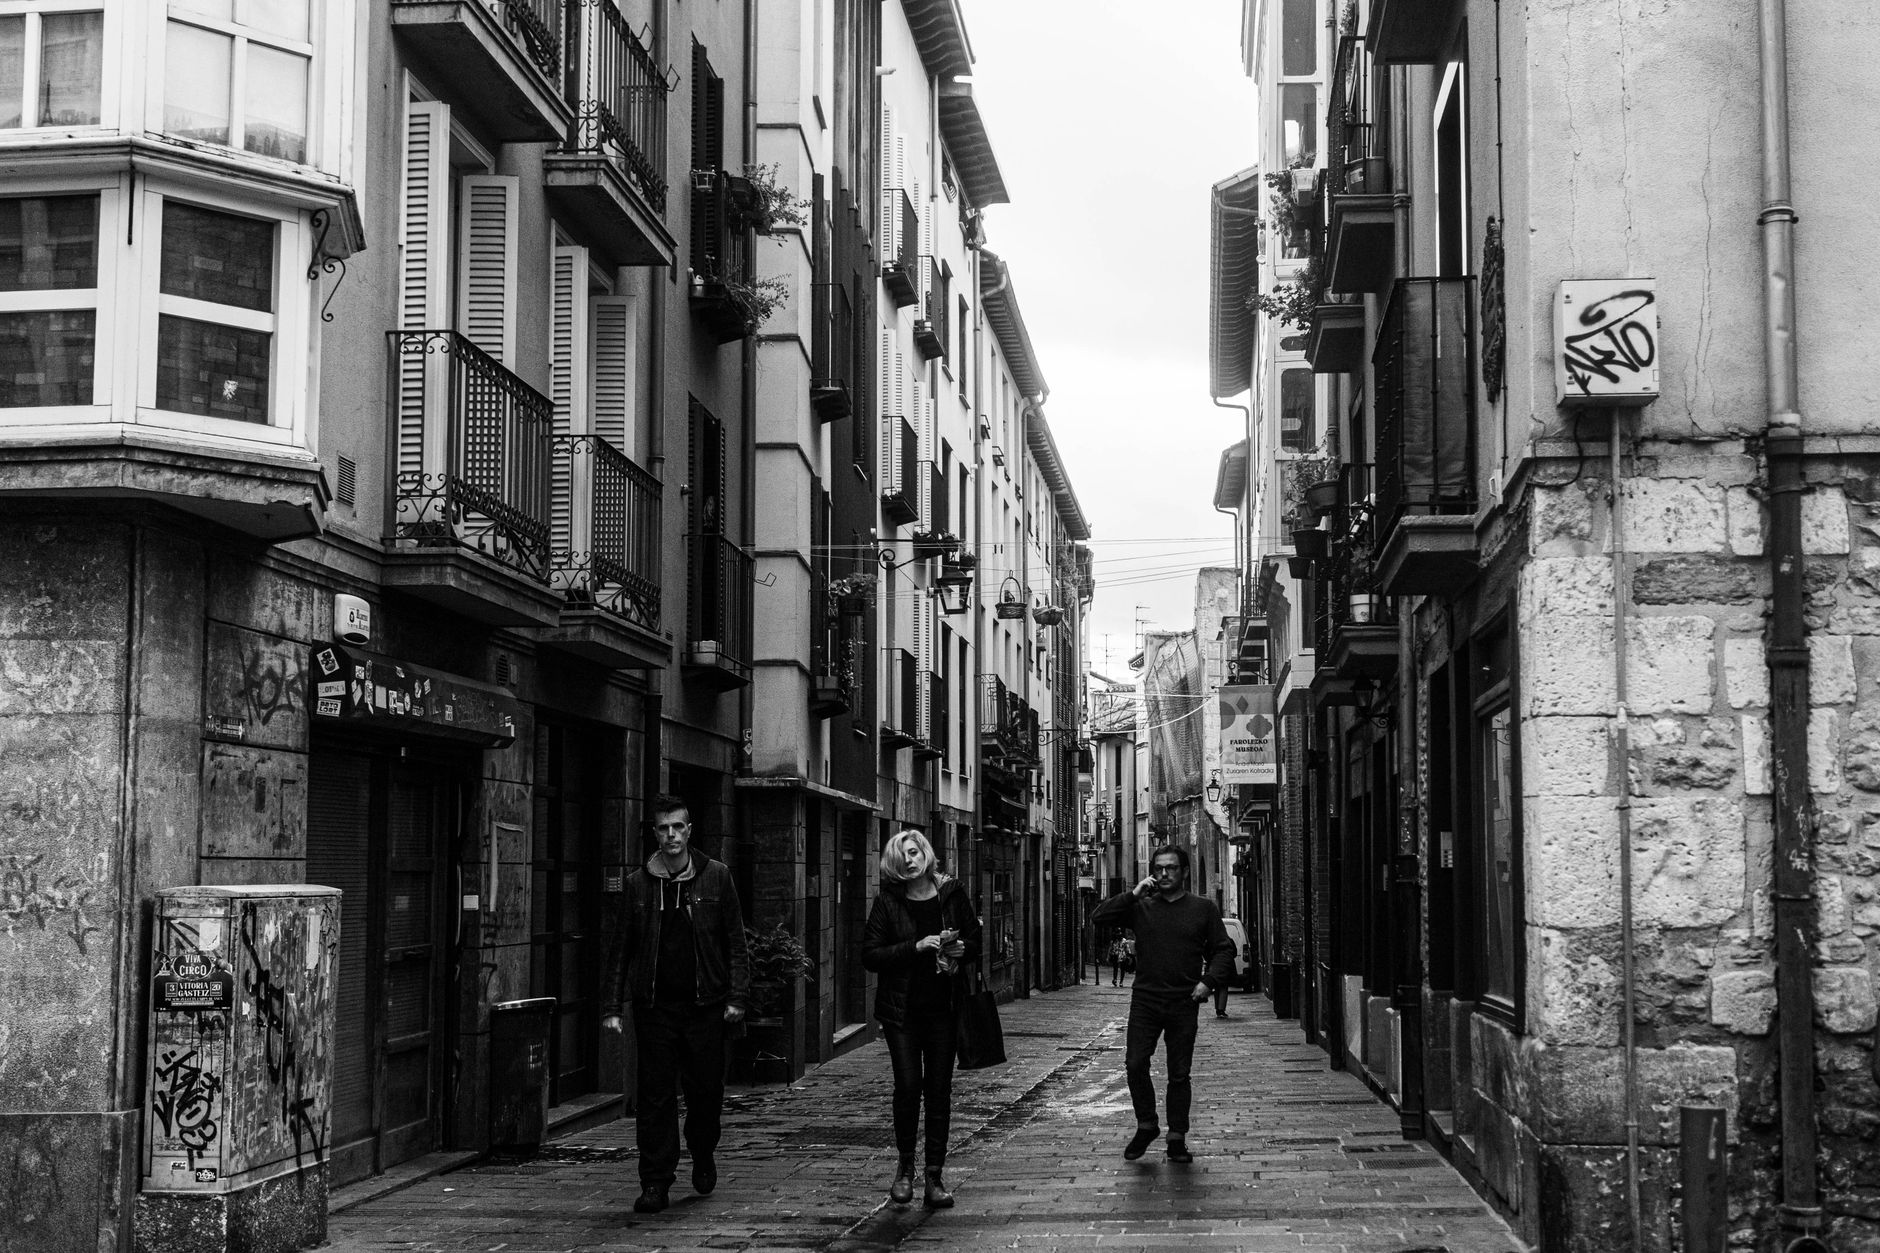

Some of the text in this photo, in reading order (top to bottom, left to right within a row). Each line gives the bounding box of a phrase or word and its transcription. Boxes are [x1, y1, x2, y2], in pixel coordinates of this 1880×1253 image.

[184, 955, 201, 963] VIVA
[179, 965, 207, 976] CIRCO
[169, 984, 175, 992] 3
[178, 989, 210, 997] GASTEIZ
